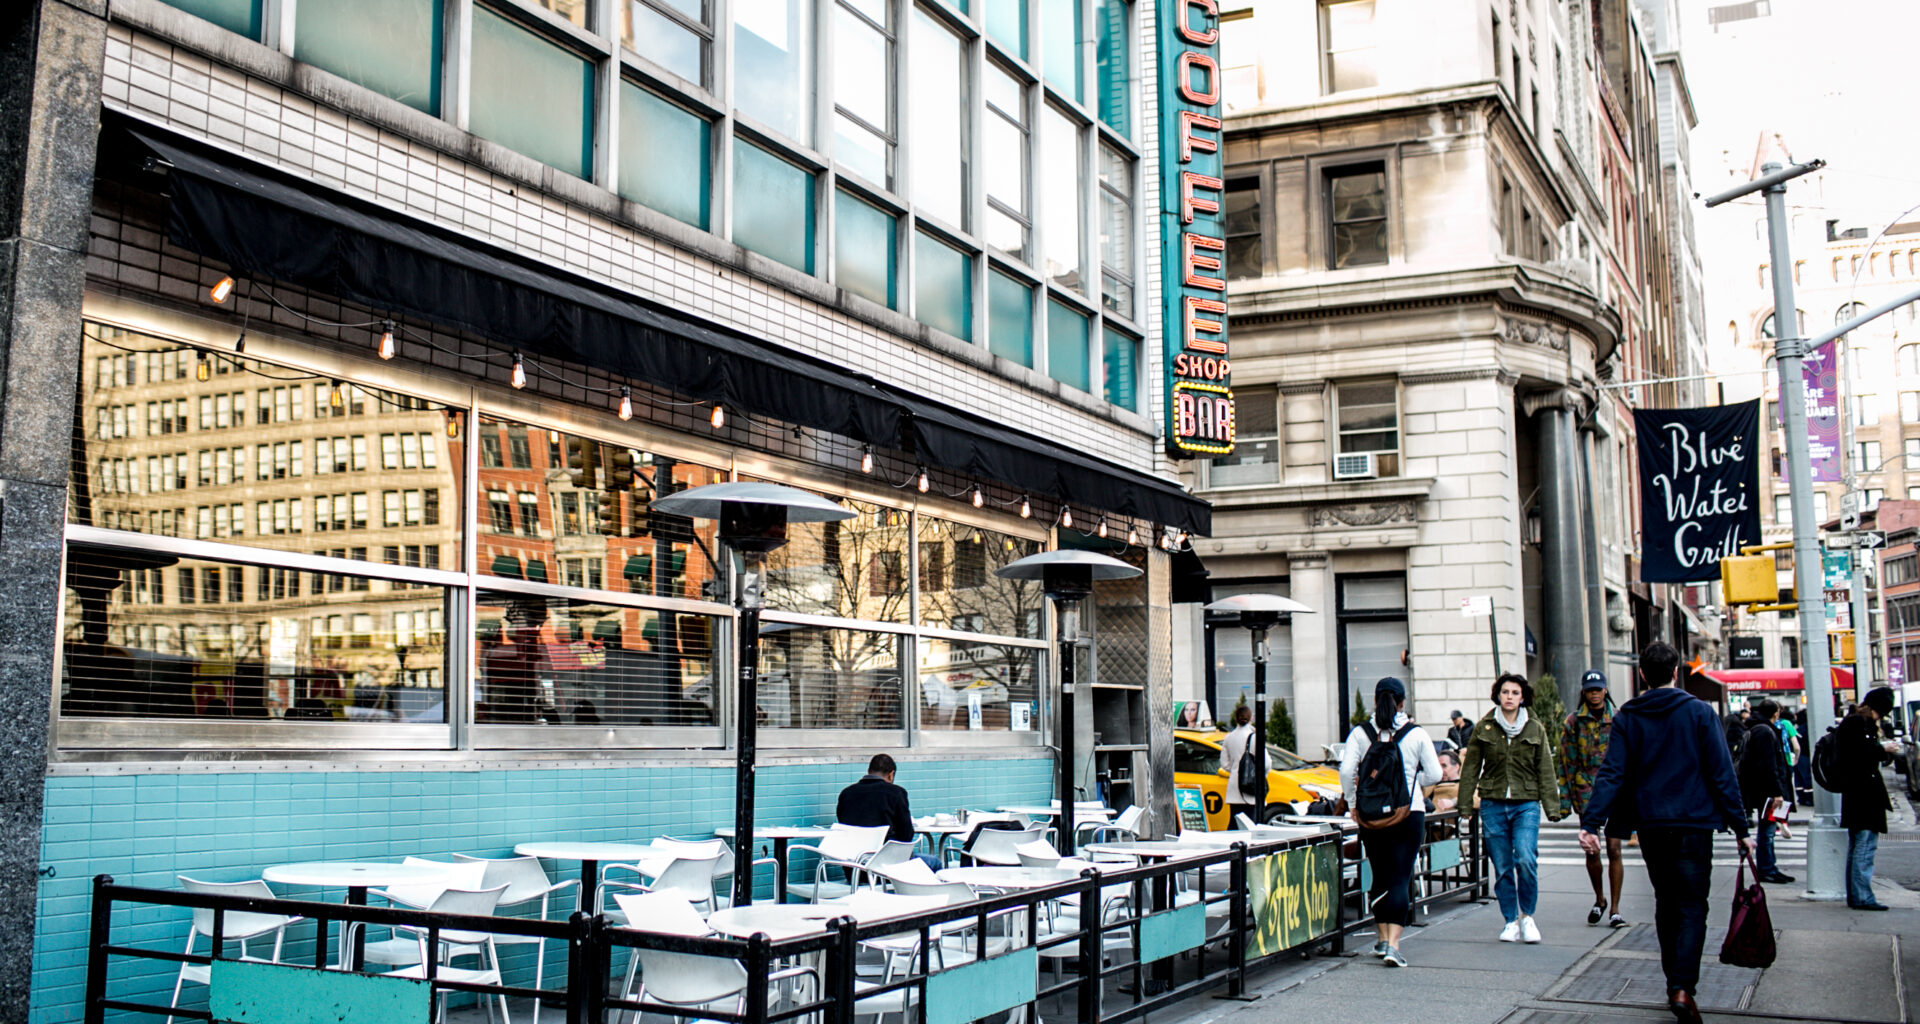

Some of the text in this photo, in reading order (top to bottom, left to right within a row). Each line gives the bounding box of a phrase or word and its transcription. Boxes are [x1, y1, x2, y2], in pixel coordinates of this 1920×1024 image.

[1177, 0, 1227, 354] COFFEE
[1175, 353, 1231, 380] SHOP
[1178, 393, 1231, 442] BAR
[1805, 406, 1837, 417] UARE
[1836, 592, 1845, 601] St
[1727, 681, 1761, 689] onald's
[972, 699, 980, 719] A
[1207, 796, 1219, 812] T
[1303, 846, 1329, 940] Shop
